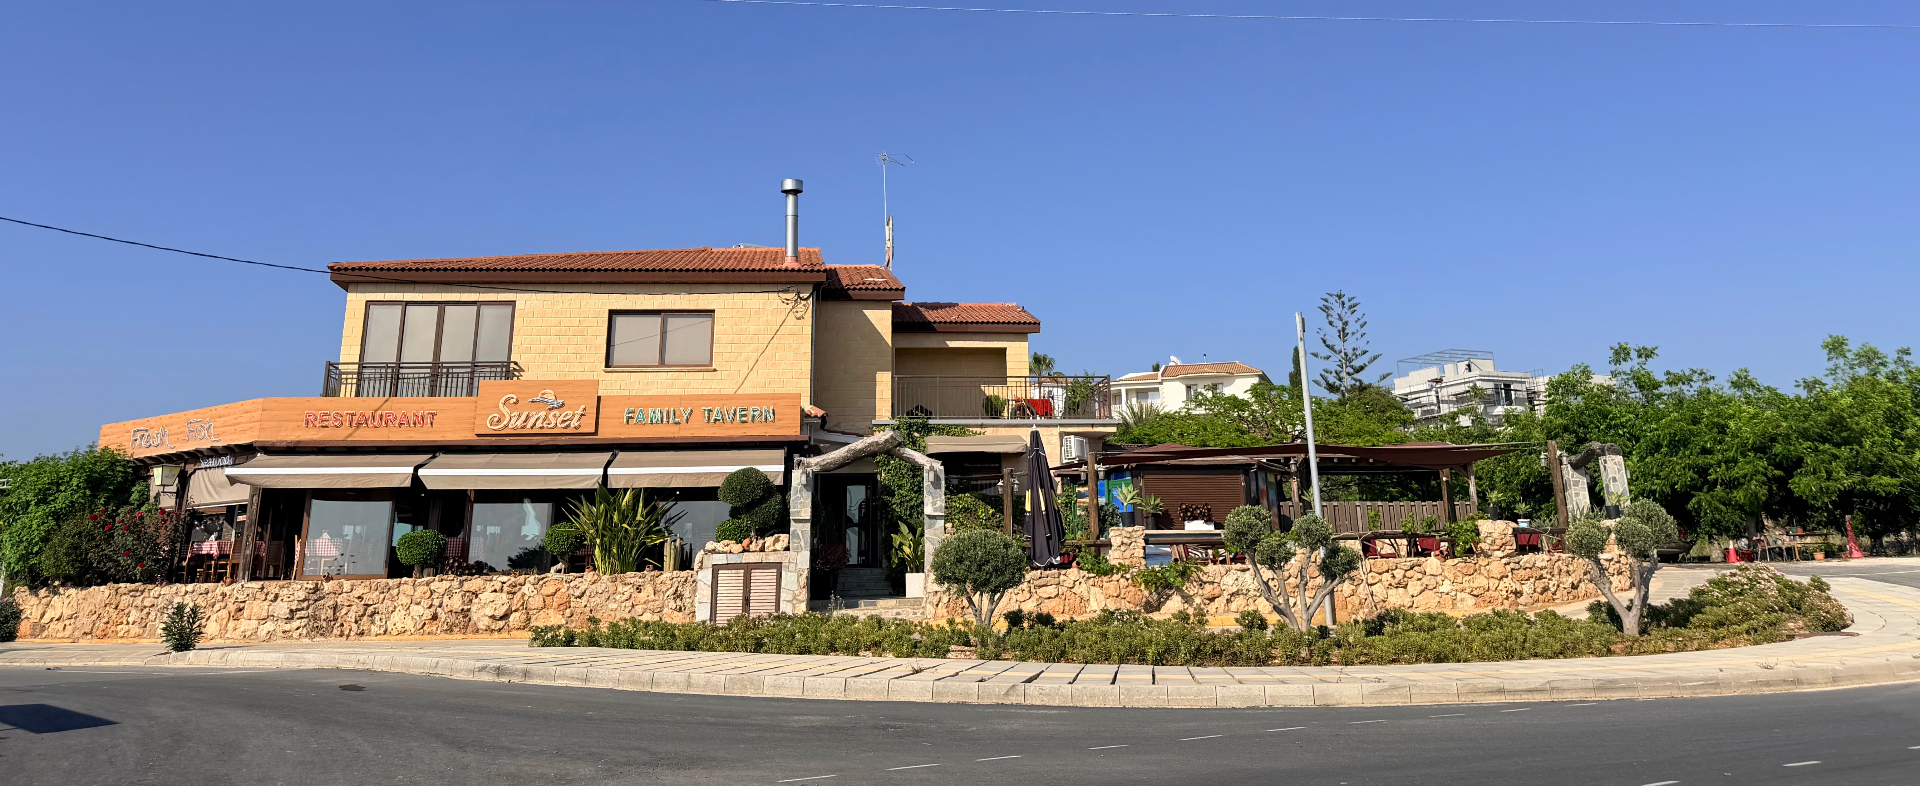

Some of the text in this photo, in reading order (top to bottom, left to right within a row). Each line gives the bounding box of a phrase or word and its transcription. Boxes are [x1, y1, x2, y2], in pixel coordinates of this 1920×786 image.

[304, 411, 437, 428] RESTAURANT
[487, 394, 587, 431] Sunset
[623, 406, 775, 425] FAMILY TAVERN
[130, 418, 221, 449] Fresh Fish
